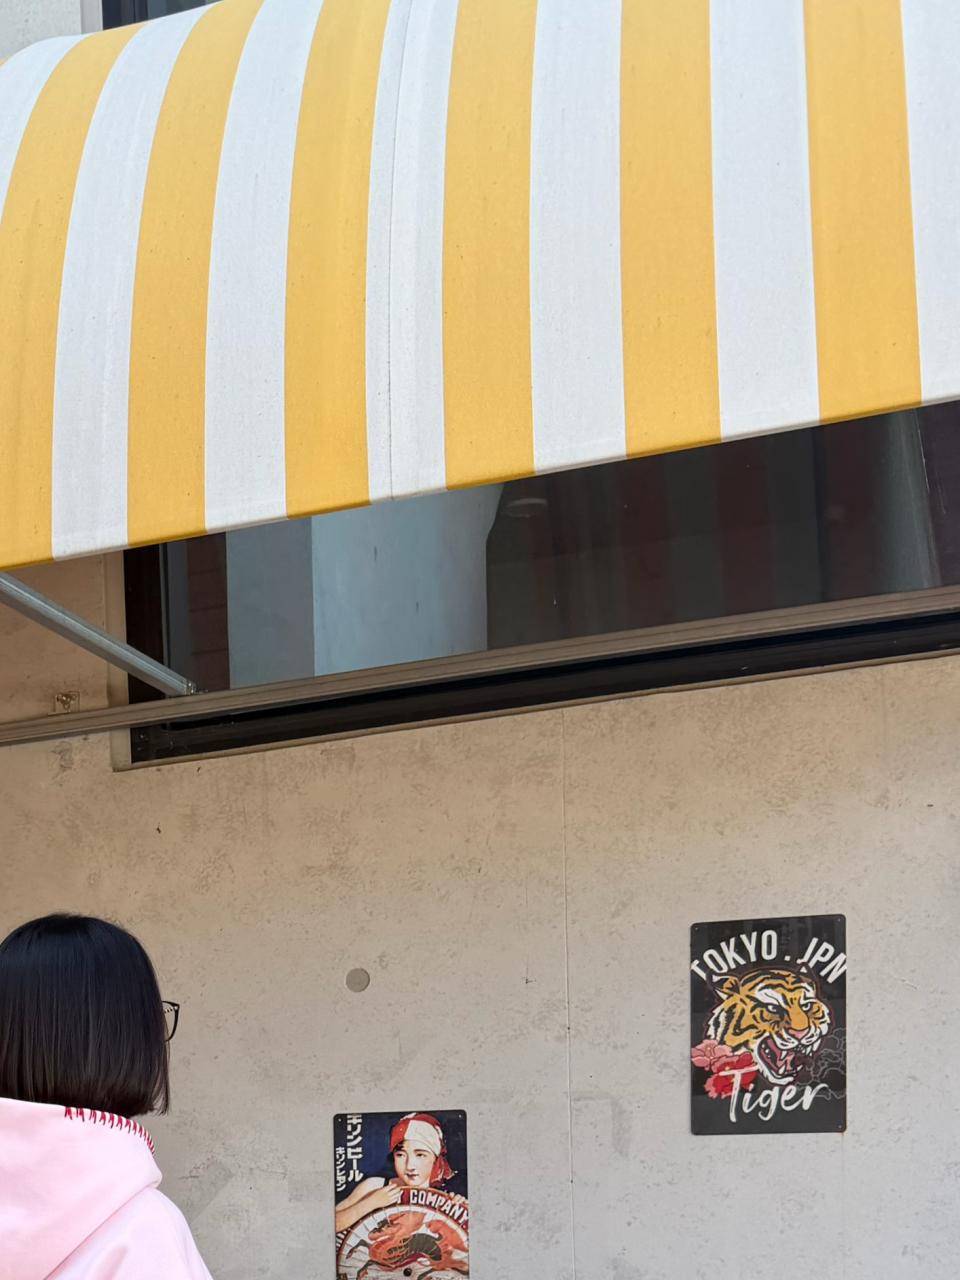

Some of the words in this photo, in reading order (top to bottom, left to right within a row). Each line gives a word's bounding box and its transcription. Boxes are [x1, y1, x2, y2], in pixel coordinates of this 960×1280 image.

[797, 937, 847, 983] JPN
[719, 1065, 829, 1122] Tiger
[347, 1114, 364, 1182] キリンビール
